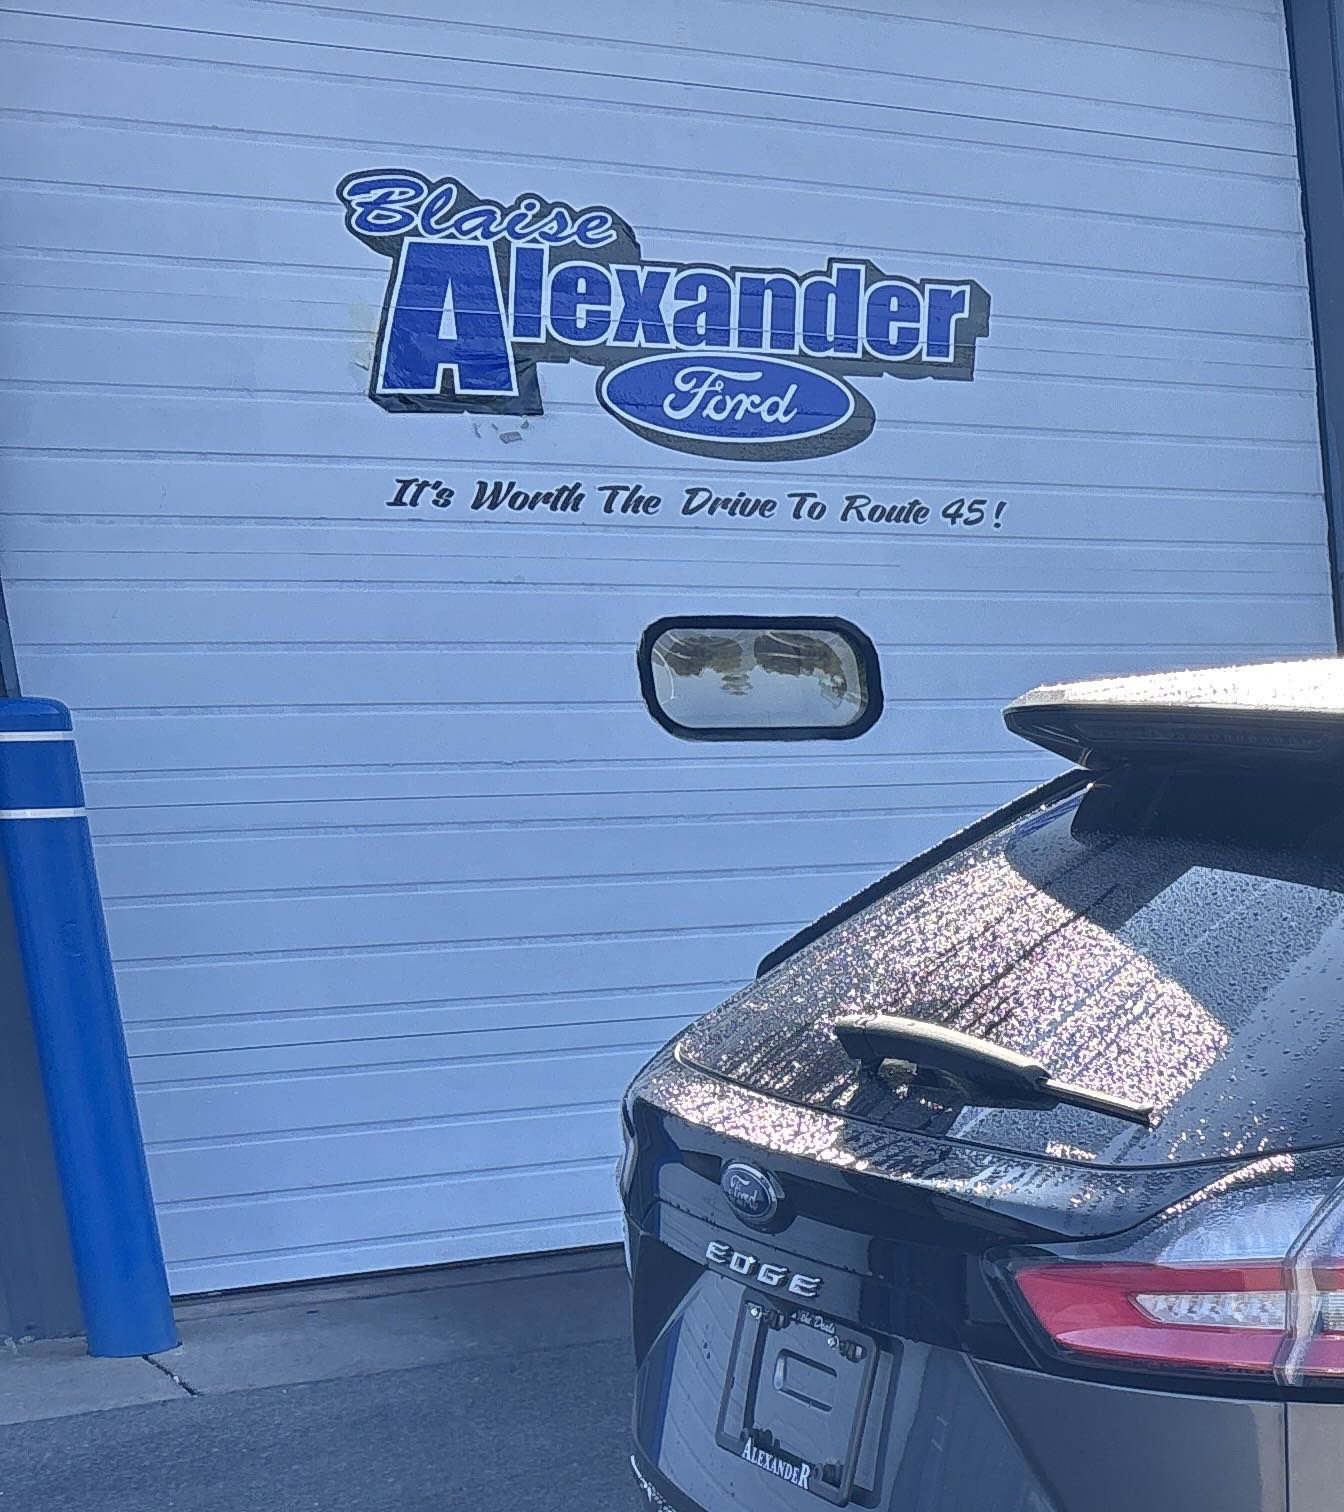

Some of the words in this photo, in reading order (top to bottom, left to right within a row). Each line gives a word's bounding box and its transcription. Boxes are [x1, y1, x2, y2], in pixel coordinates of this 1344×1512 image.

[343, 173, 618, 246] Blaise
[378, 236, 972, 397] Alexander
[663, 366, 797, 424] Ford
[387, 477, 455, 510] It's
[471, 480, 583, 516] Worth
[597, 484, 662, 516] The
[682, 489, 778, 520] Drive
[787, 492, 828, 522] To
[840, 494, 930, 527] Route
[727, 1175, 761, 1210] Ford
[704, 1239, 823, 1298] EDGE
[741, 1437, 812, 1490] ALEXANDER
